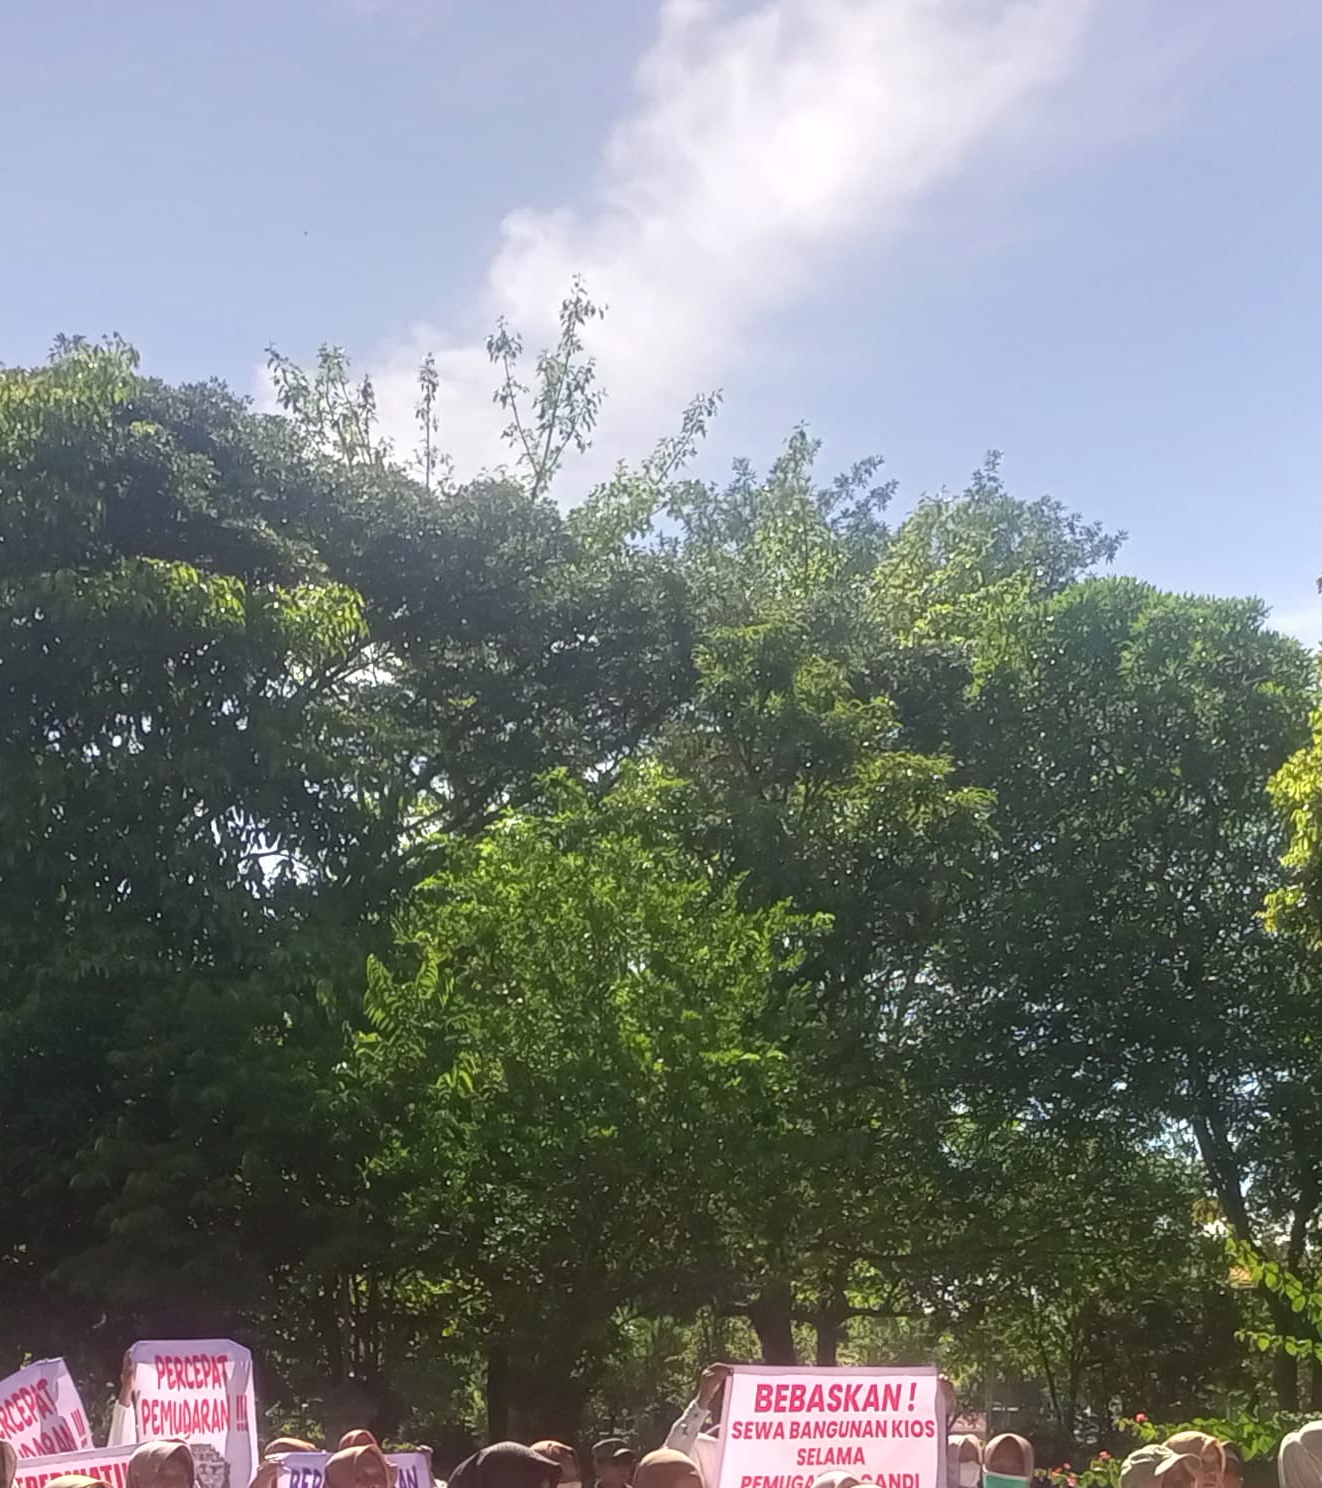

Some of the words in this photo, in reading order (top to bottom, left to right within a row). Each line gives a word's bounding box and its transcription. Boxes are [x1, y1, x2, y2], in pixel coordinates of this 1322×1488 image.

[155, 1355, 229, 1390] PERCEPAT
[236, 1394, 248, 1432] !!!
[754, 1383, 902, 1414] BEBASKAN
[731, 1421, 785, 1440] SEWA
[789, 1420, 888, 1439] BANGUNAN
[891, 1419, 936, 1438] KIOS
[797, 1447, 866, 1466] SELAMA
